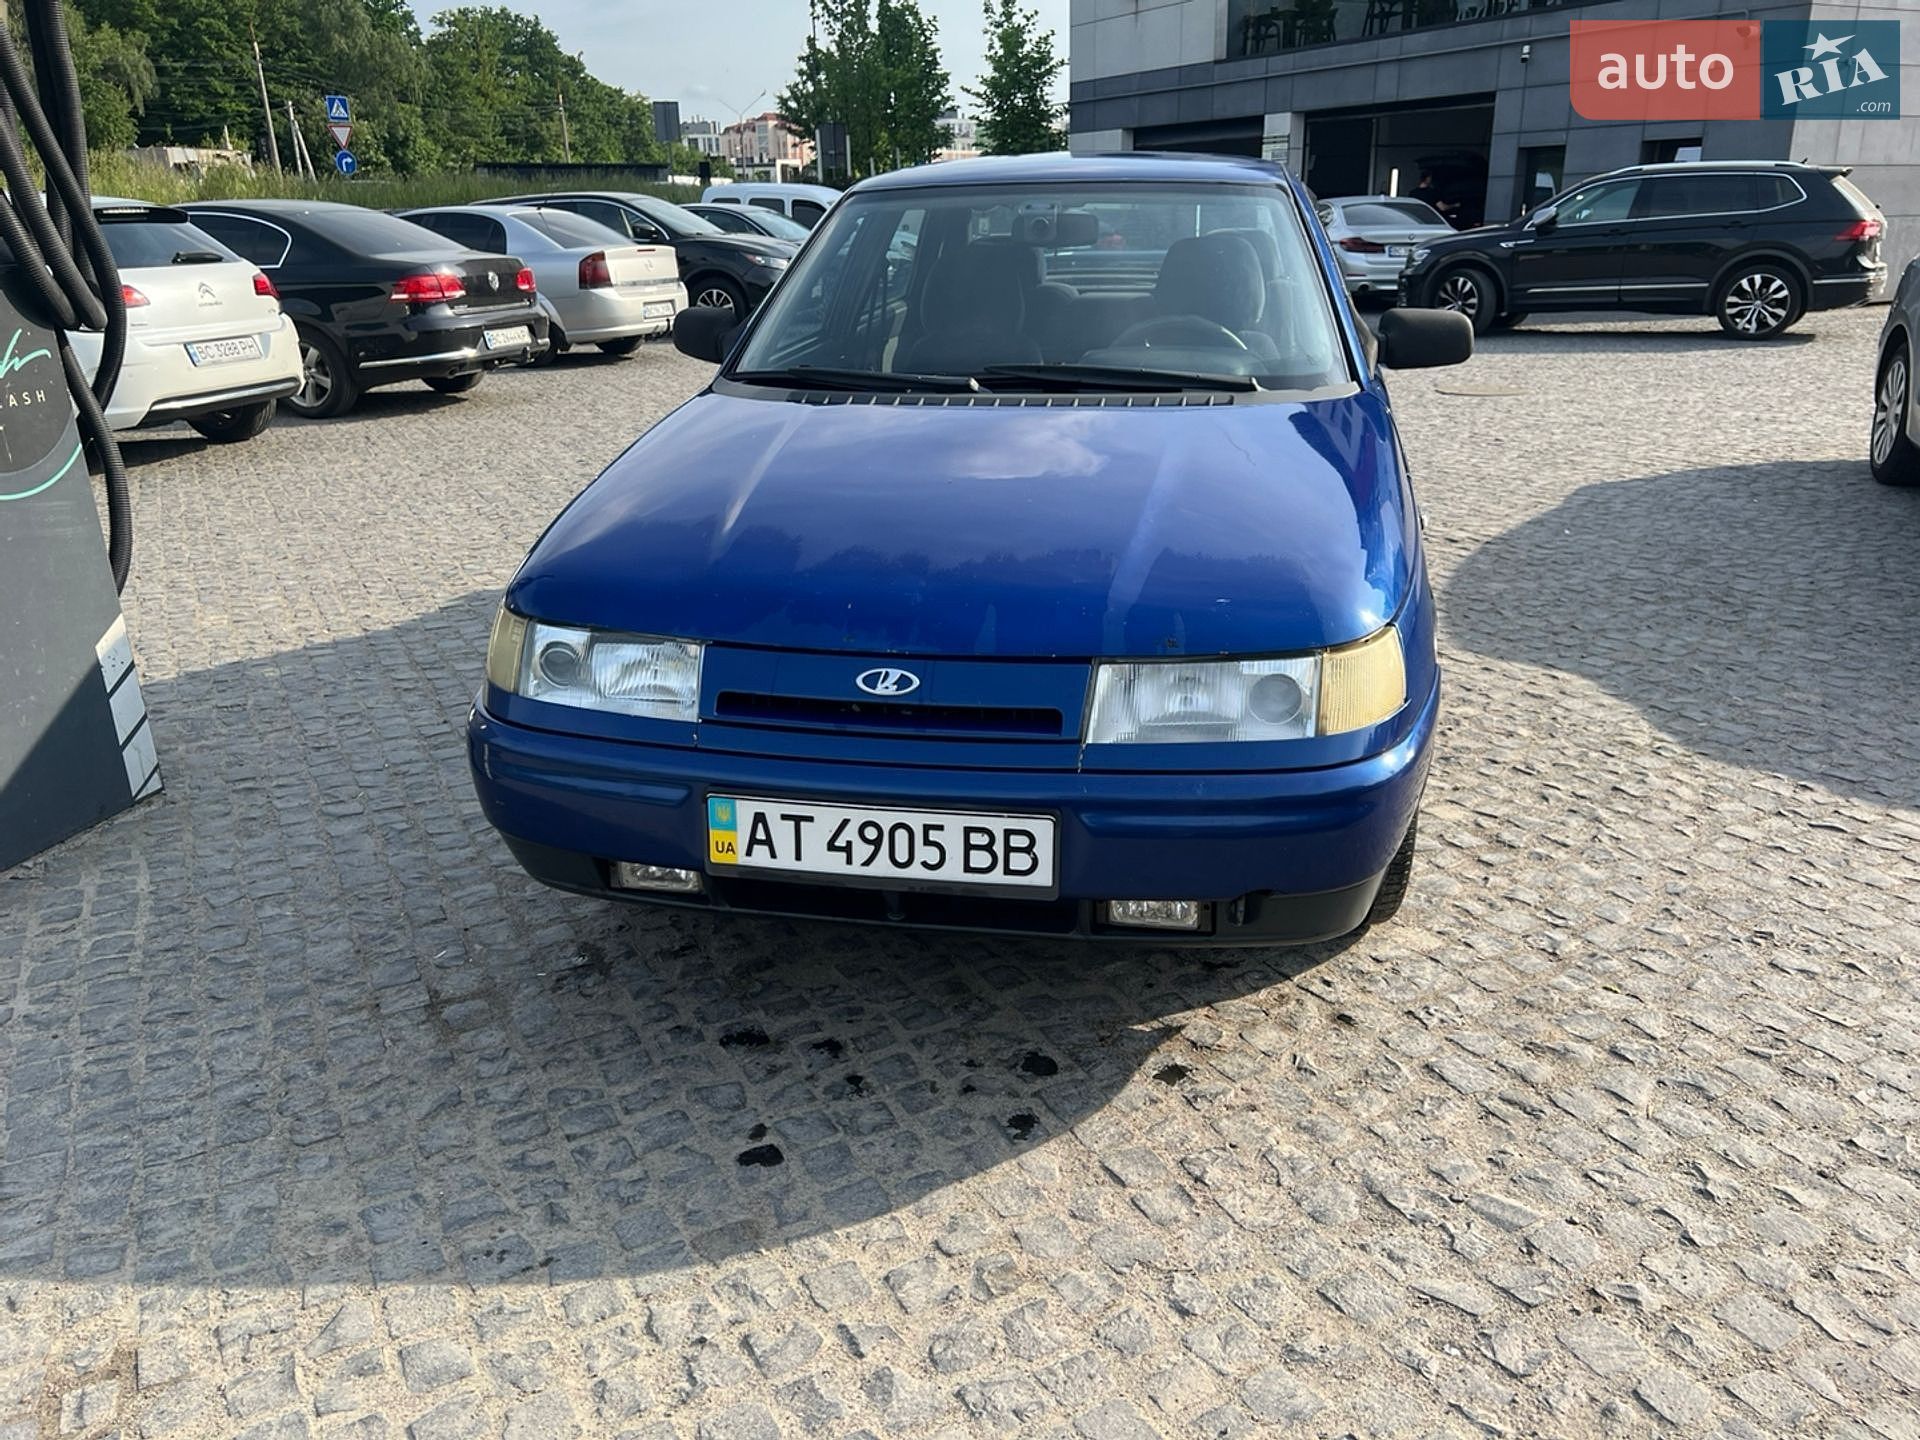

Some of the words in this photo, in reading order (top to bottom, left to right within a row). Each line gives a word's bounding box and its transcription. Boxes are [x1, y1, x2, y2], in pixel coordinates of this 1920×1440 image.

[196, 345, 215, 360] BC
[0, 389, 46, 408] ASH
[715, 840, 736, 855] UA
[745, 811, 815, 862] AT
[827, 818, 947, 871] 4905
[963, 825, 1039, 877] BB
